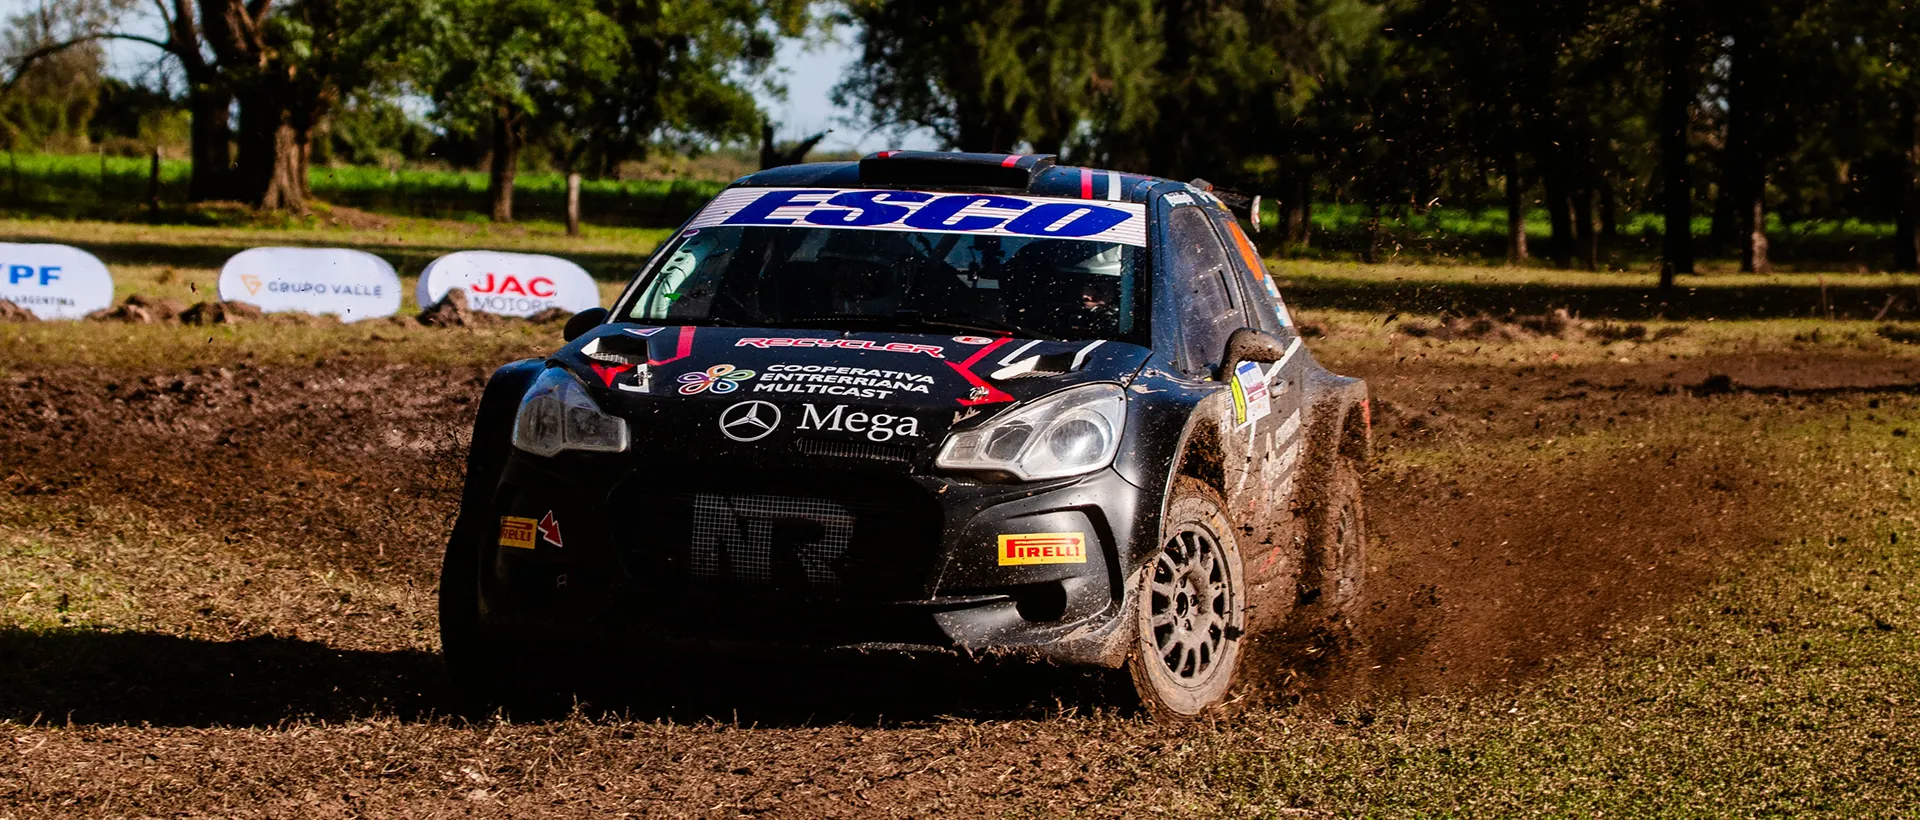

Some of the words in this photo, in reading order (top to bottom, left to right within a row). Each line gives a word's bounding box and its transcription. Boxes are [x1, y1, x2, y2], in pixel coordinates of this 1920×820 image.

[722, 189, 1133, 237] ESCO
[0, 263, 62, 286] PF
[470, 273, 555, 297] JAC
[267, 281, 326, 294] GRUPO
[734, 337, 945, 359] RECYCLER
[759, 373, 930, 394] ENTRERRIANA
[767, 364, 935, 385] COOPERATIVA
[753, 383, 894, 400] MULTICAST
[797, 403, 919, 442] Mega
[1006, 538, 1080, 558] PIRELLI
